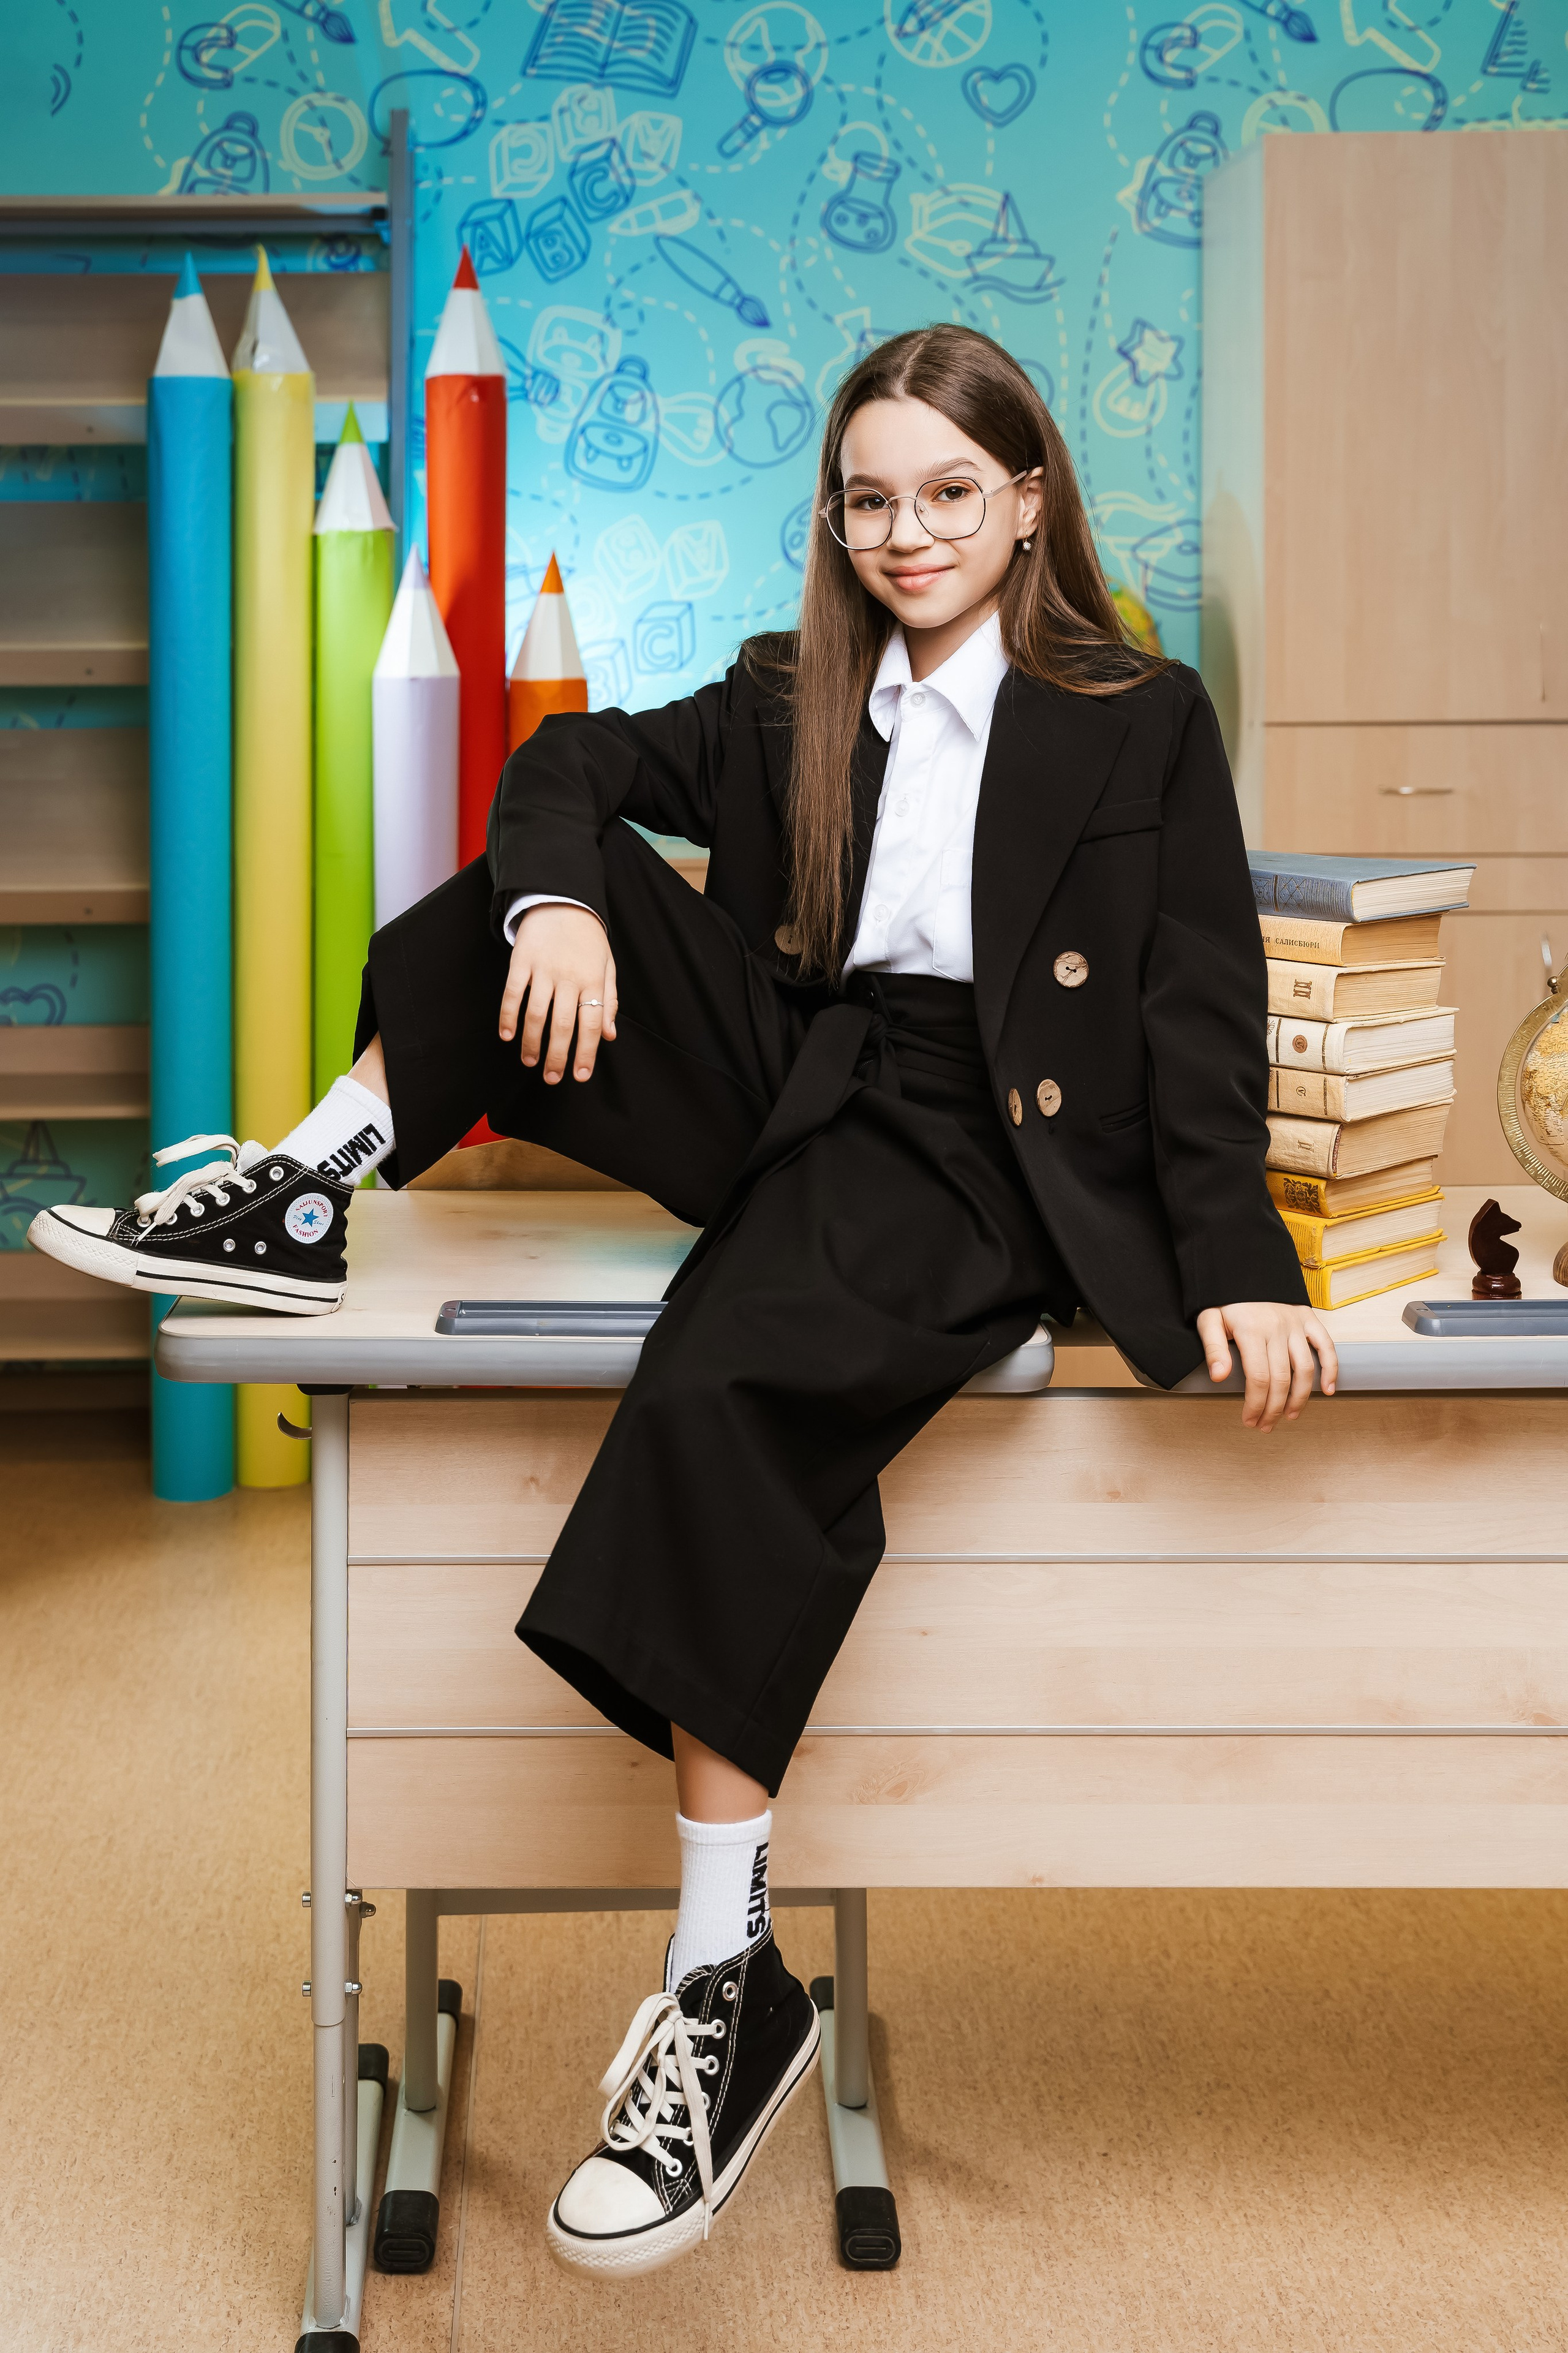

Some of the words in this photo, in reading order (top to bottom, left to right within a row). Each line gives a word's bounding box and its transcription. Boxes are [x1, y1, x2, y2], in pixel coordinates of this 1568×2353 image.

[581, 164, 620, 213] C
[642, 623, 674, 669] C
[1275, 937, 1320, 949] САЛИСБЮРИ
[317, 1123, 386, 1180] LIMITS
[292, 1224, 318, 1237] FASHION
[747, 1840, 769, 1938] LIMITS
